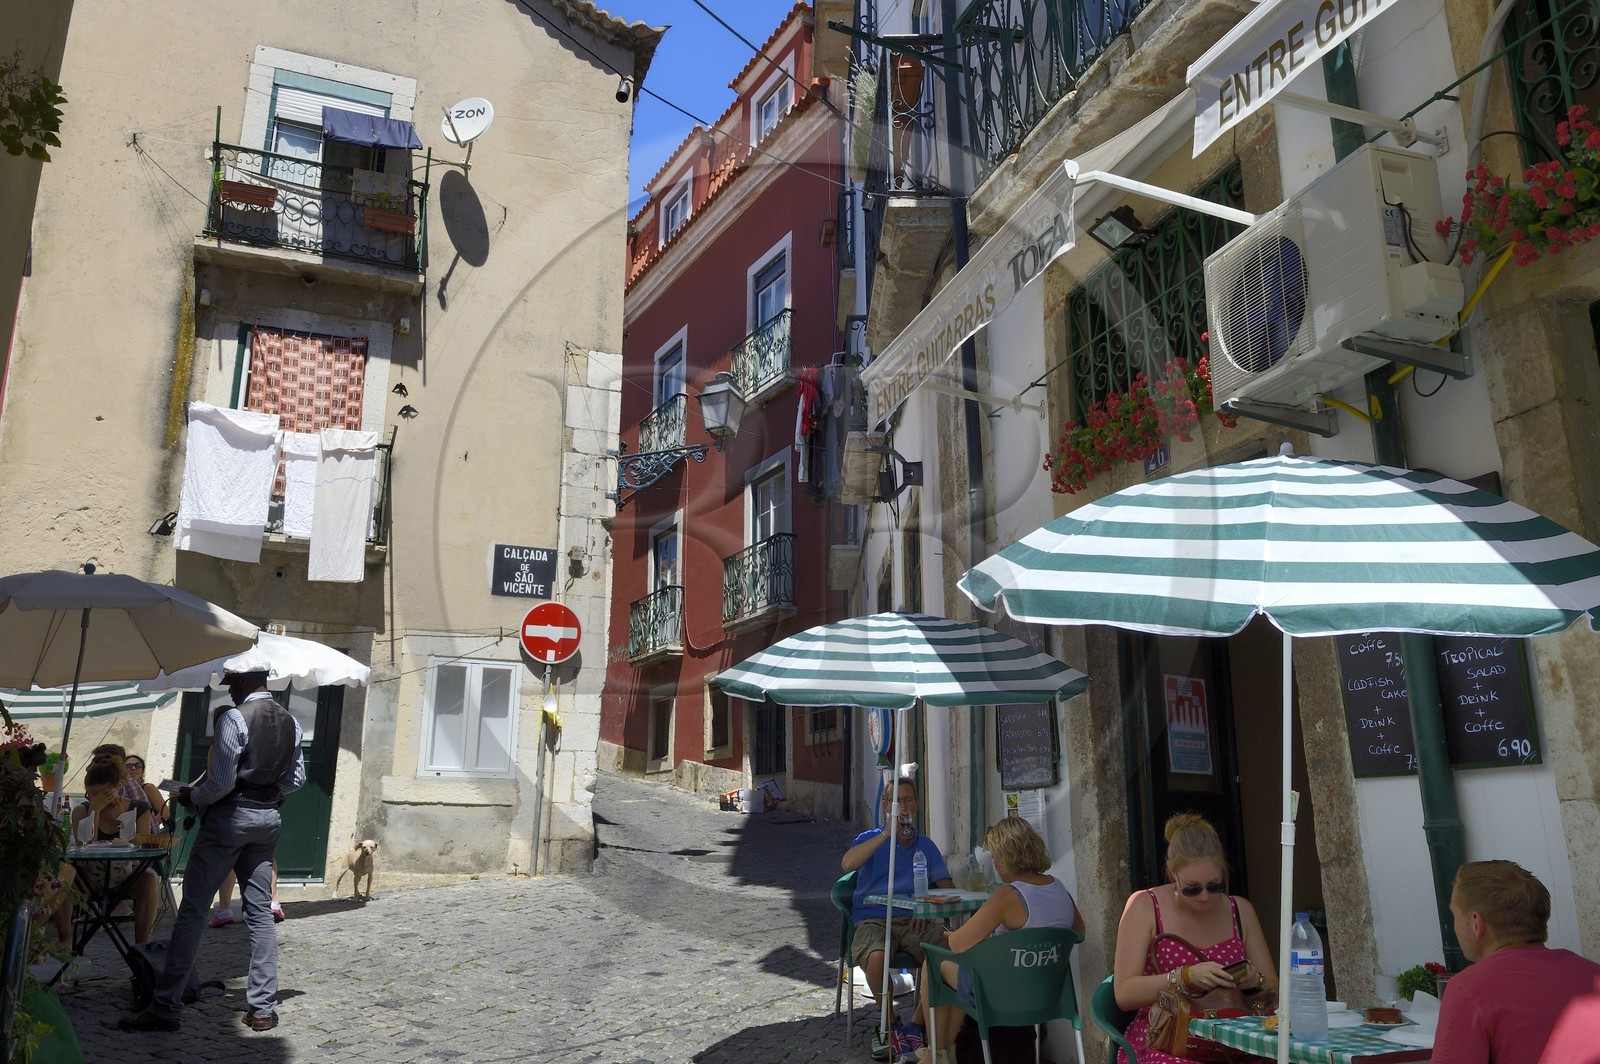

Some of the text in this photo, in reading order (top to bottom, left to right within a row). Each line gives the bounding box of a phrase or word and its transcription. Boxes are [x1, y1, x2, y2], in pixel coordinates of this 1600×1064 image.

[1219, 20, 1305, 128] ENTRE
[454, 107, 486, 119] ZON
[1006, 212, 1070, 294] TOFA
[876, 283, 996, 420] ENTRE GUITARRAS
[503, 547, 548, 562] CALÇADA
[520, 563, 531, 572] DE
[514, 571, 534, 583] SÃO
[503, 581, 545, 595] VICENTE
[1467, 665, 1506, 680] SALAD
[1498, 738, 1531, 758] 6.90
[1010, 945, 1060, 968] TOFA
